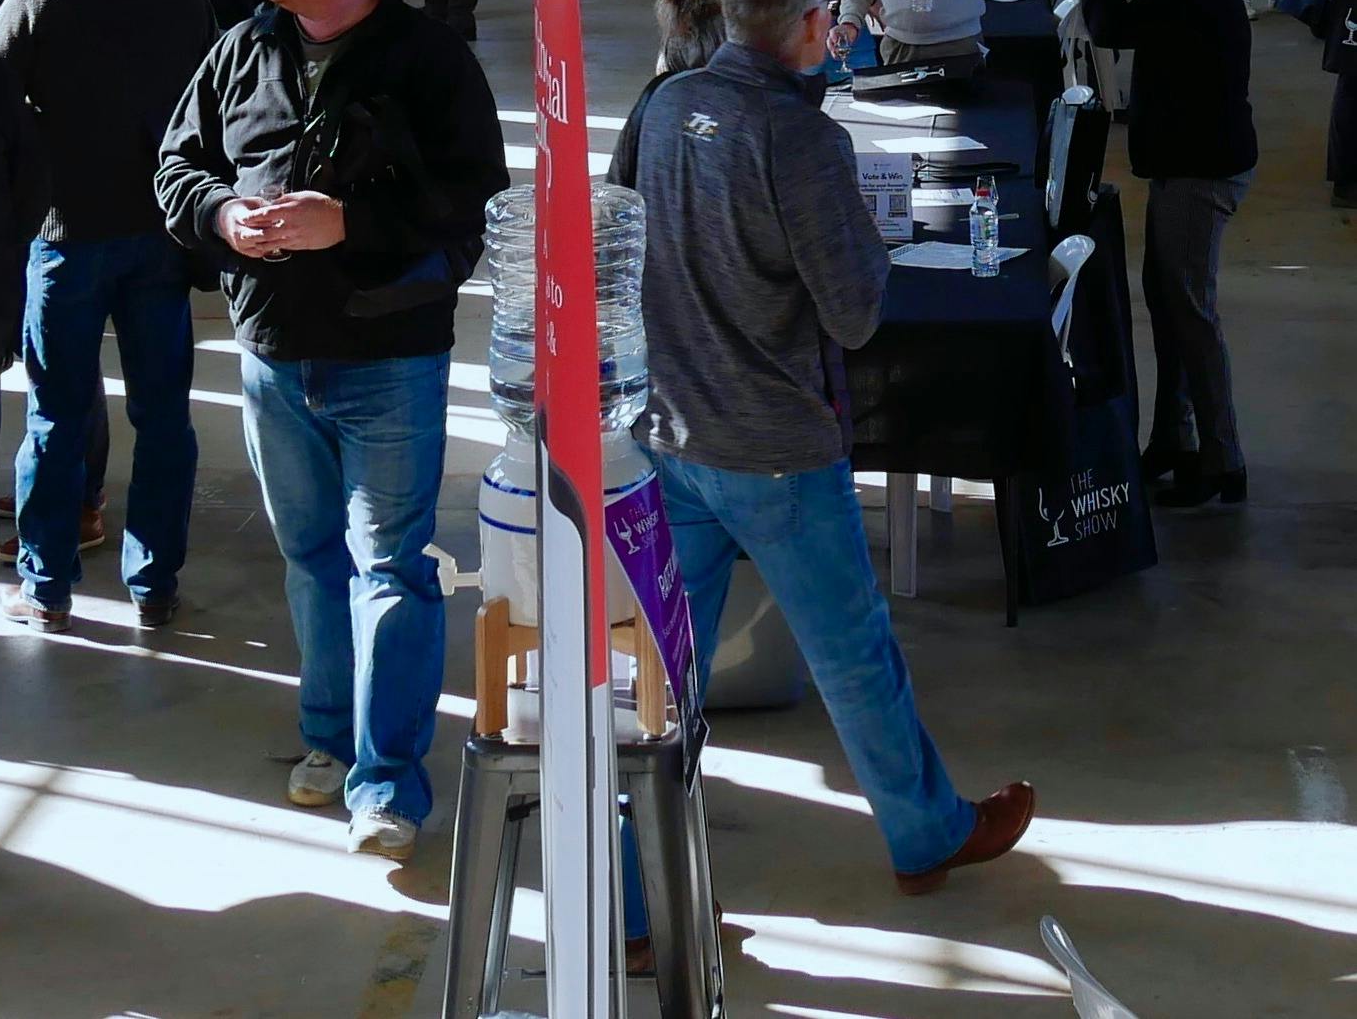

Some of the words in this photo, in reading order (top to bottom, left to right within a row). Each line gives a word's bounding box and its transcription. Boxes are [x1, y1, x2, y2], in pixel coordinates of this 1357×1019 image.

[862, 172, 879, 180] Vote
[888, 172, 904, 180] Win
[1070, 468, 1095, 494] THE
[1071, 481, 1130, 518] WHISKY
[1075, 509, 1117, 541] SHOW
